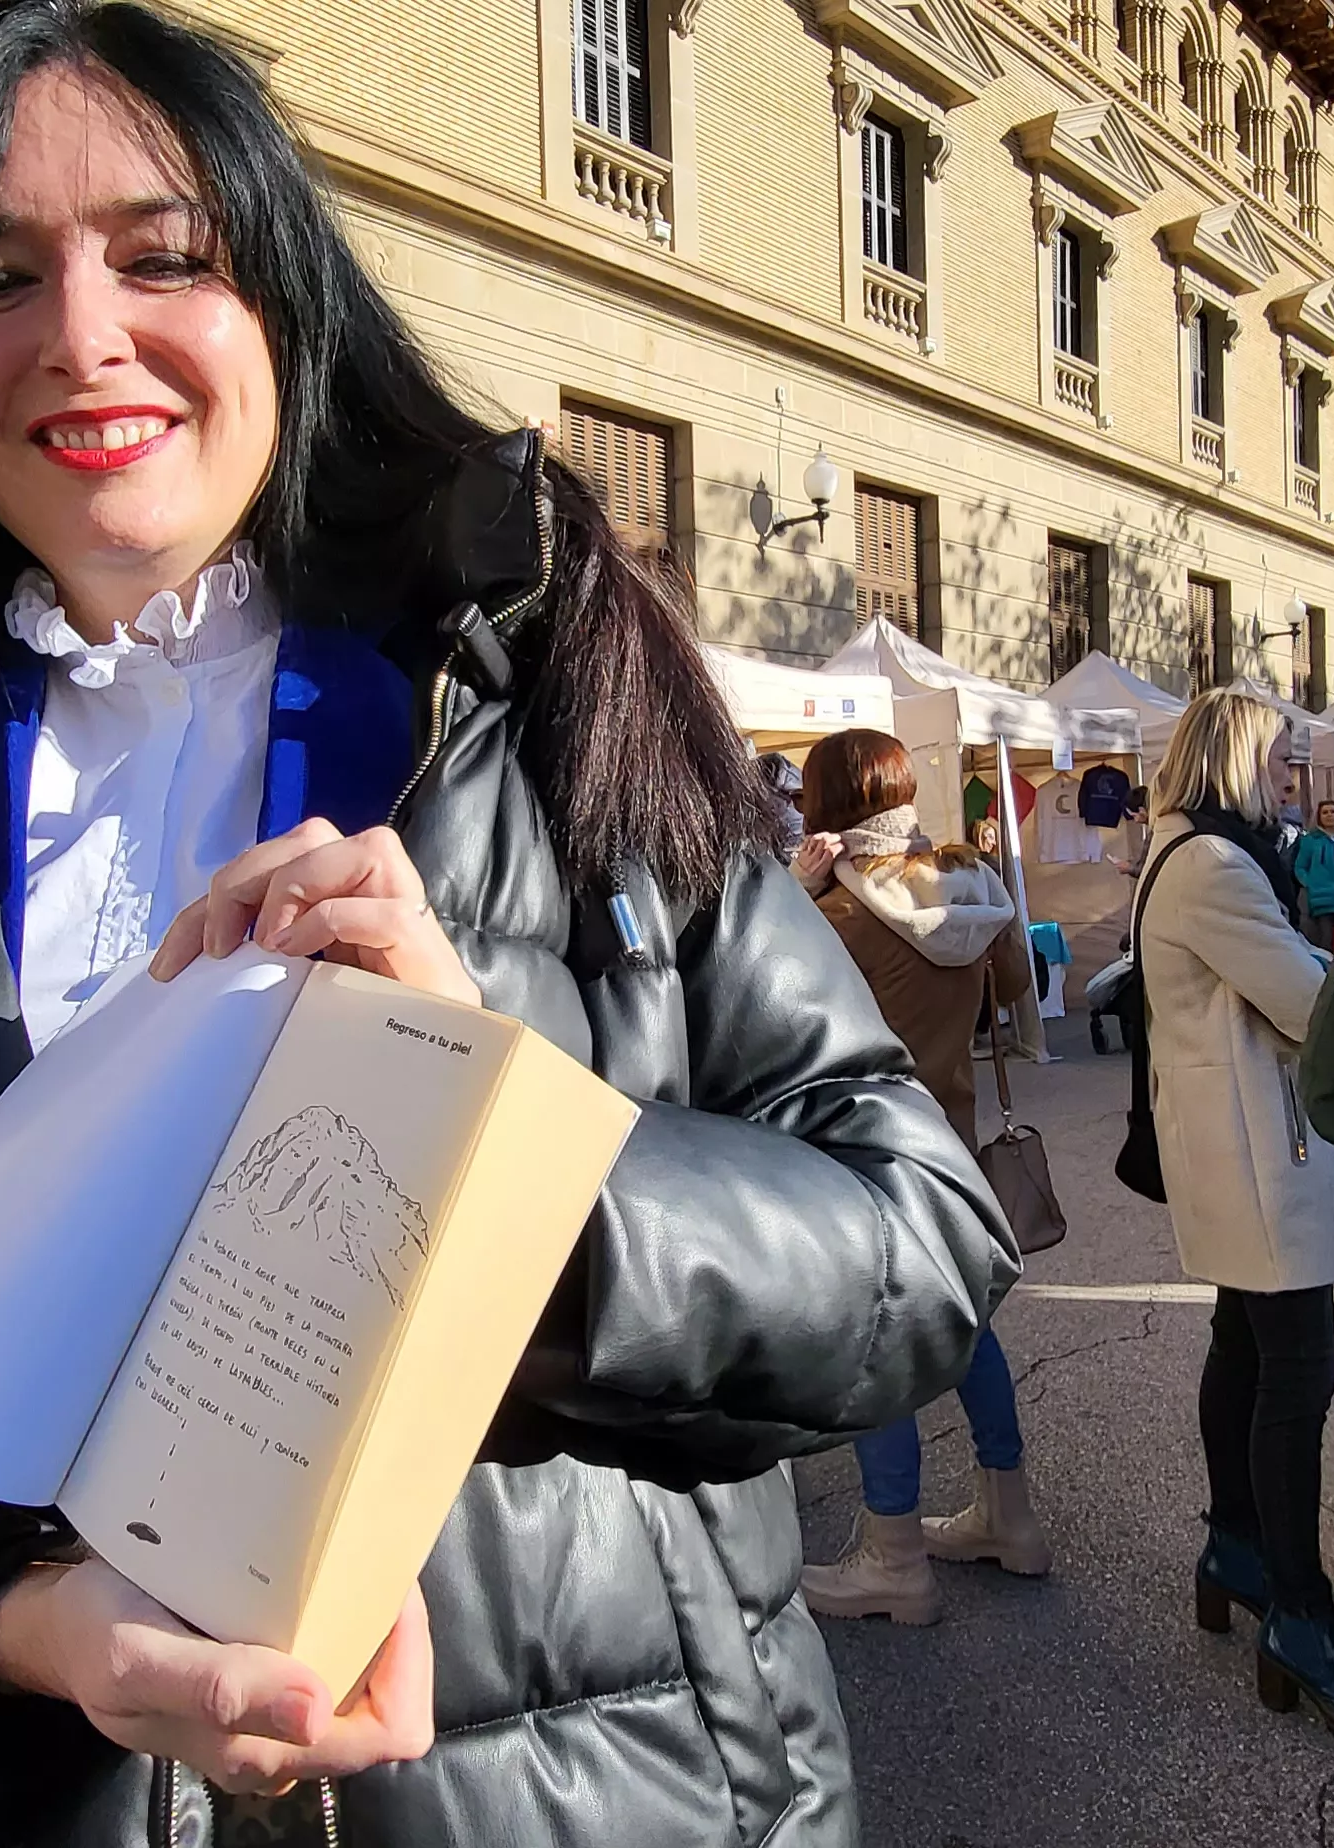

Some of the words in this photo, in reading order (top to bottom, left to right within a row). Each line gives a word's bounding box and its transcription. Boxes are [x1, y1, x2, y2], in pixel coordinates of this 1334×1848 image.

[386, 1017, 427, 1040] Regreso
[428, 1034, 436, 1043] a
[437, 1035, 449, 1048] tu
[449, 1041, 473, 1056] piel
[309, 1294, 346, 1322] TRASPASA
[159, 1320, 169, 1333] DE
[170, 1328, 183, 1342] LAS
[205, 1292, 214, 1305] EL
[329, 1364, 340, 1377] LA
[284, 1311, 296, 1325] DE
[300, 1319, 311, 1333] LA
[315, 1330, 353, 1359] MONTAÑA
[244, 1343, 255, 1355] LA
[259, 1352, 301, 1383] TERRIBLE
[197, 1396, 220, 1416] CERCA
[223, 1411, 235, 1426] DE
